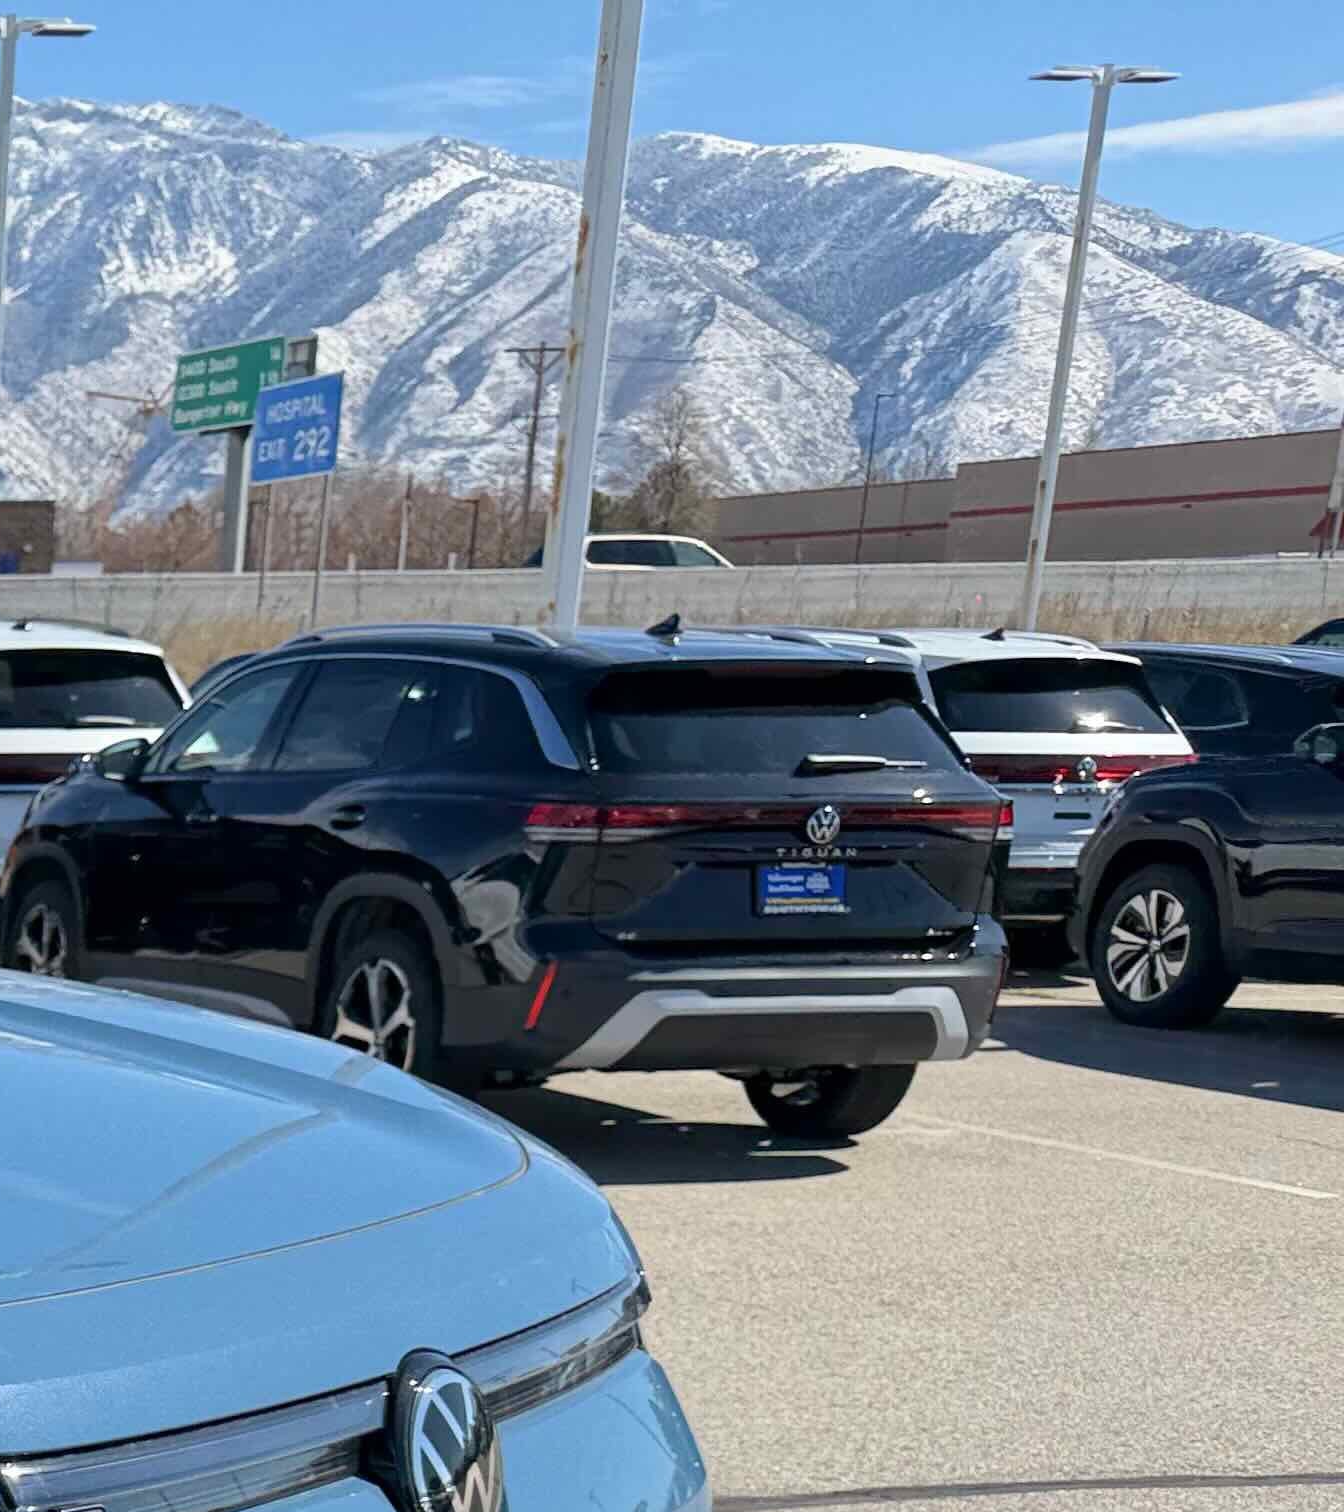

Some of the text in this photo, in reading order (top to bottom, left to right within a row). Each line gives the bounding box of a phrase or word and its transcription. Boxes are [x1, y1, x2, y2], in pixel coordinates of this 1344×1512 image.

[266, 393, 326, 424] HOSPITAL
[293, 426, 331, 461] 292
[775, 847, 858, 858] TIGUAN
